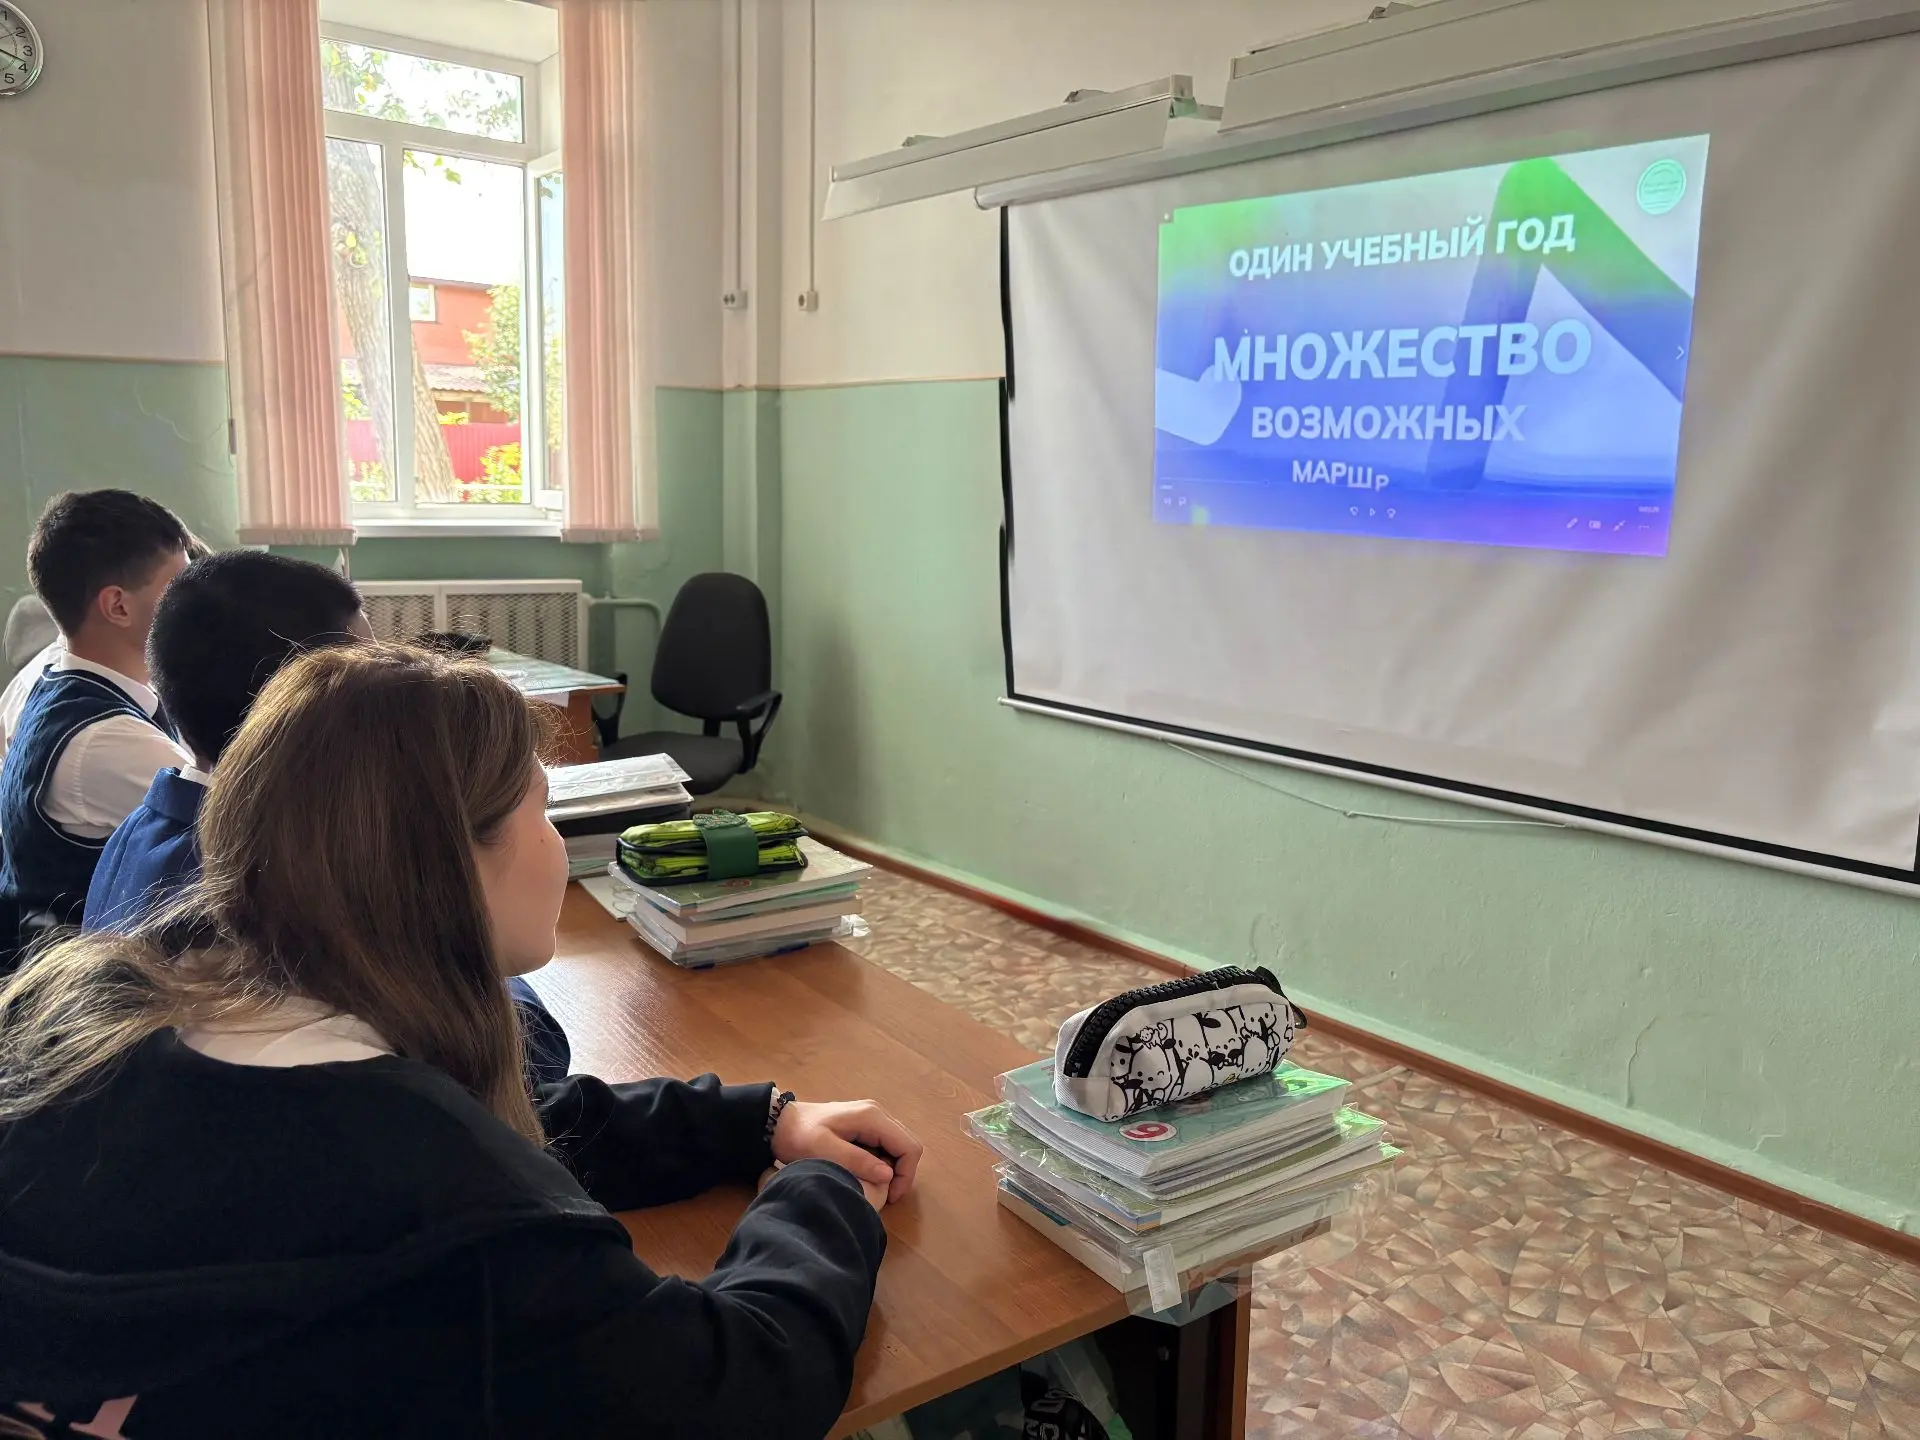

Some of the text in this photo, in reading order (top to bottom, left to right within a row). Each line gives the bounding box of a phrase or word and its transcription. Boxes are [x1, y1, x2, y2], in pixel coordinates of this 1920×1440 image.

[15, 26, 27, 39] 2
[22, 45, 33, 57] 3
[18, 63, 28, 74] 4
[4, 73, 15, 84] 5
[1229, 214, 1576, 281] ОДИН УЧЕБНЫЙ ГОД
[1213, 318, 1592, 382] МНОЖЕСТВО
[1251, 404, 1529, 442] ВОЗМОЖНЫХ
